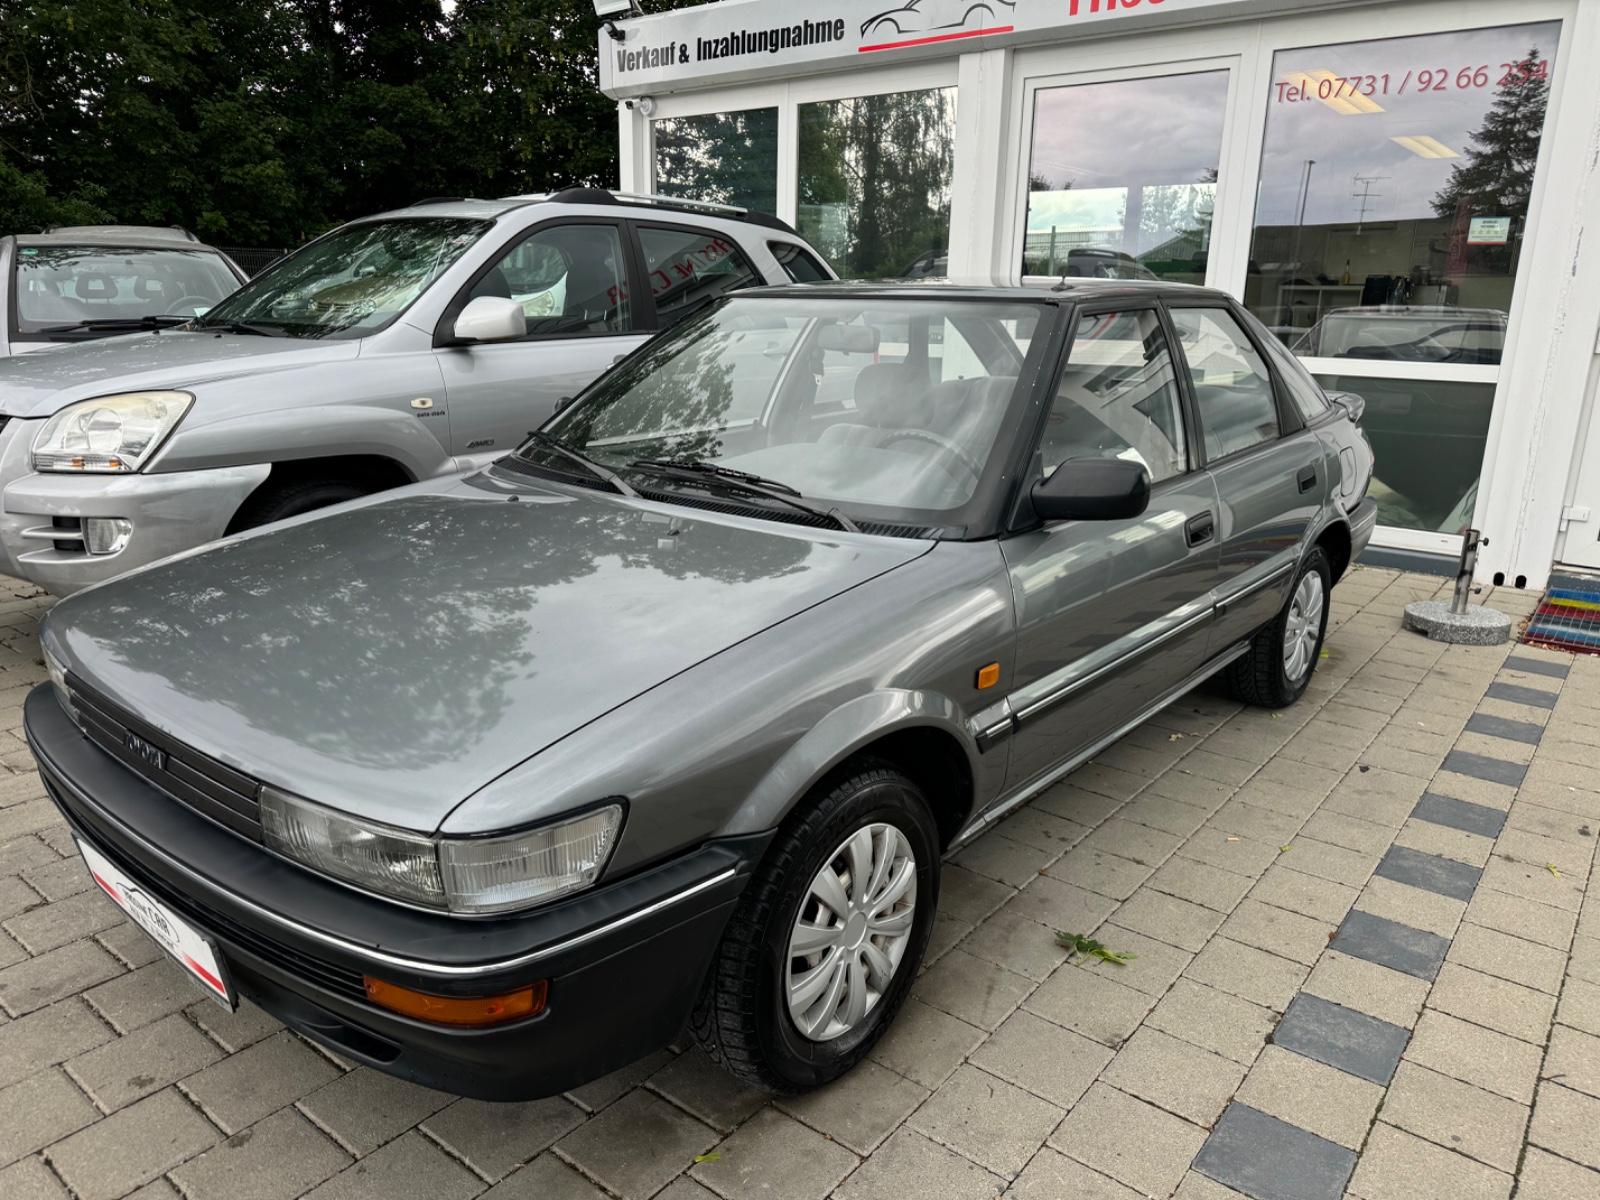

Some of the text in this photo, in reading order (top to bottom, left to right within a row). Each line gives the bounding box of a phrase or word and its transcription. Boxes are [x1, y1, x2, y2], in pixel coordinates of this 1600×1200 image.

[617, 18, 845, 72] Verkauf & Inzahlungnahme
[1275, 79, 1311, 103] Tel.
[1318, 73, 1390, 100] 07731
[1397, 70, 1412, 95] /
[1417, 68, 1449, 92] 92
[1455, 64, 1489, 90] 66
